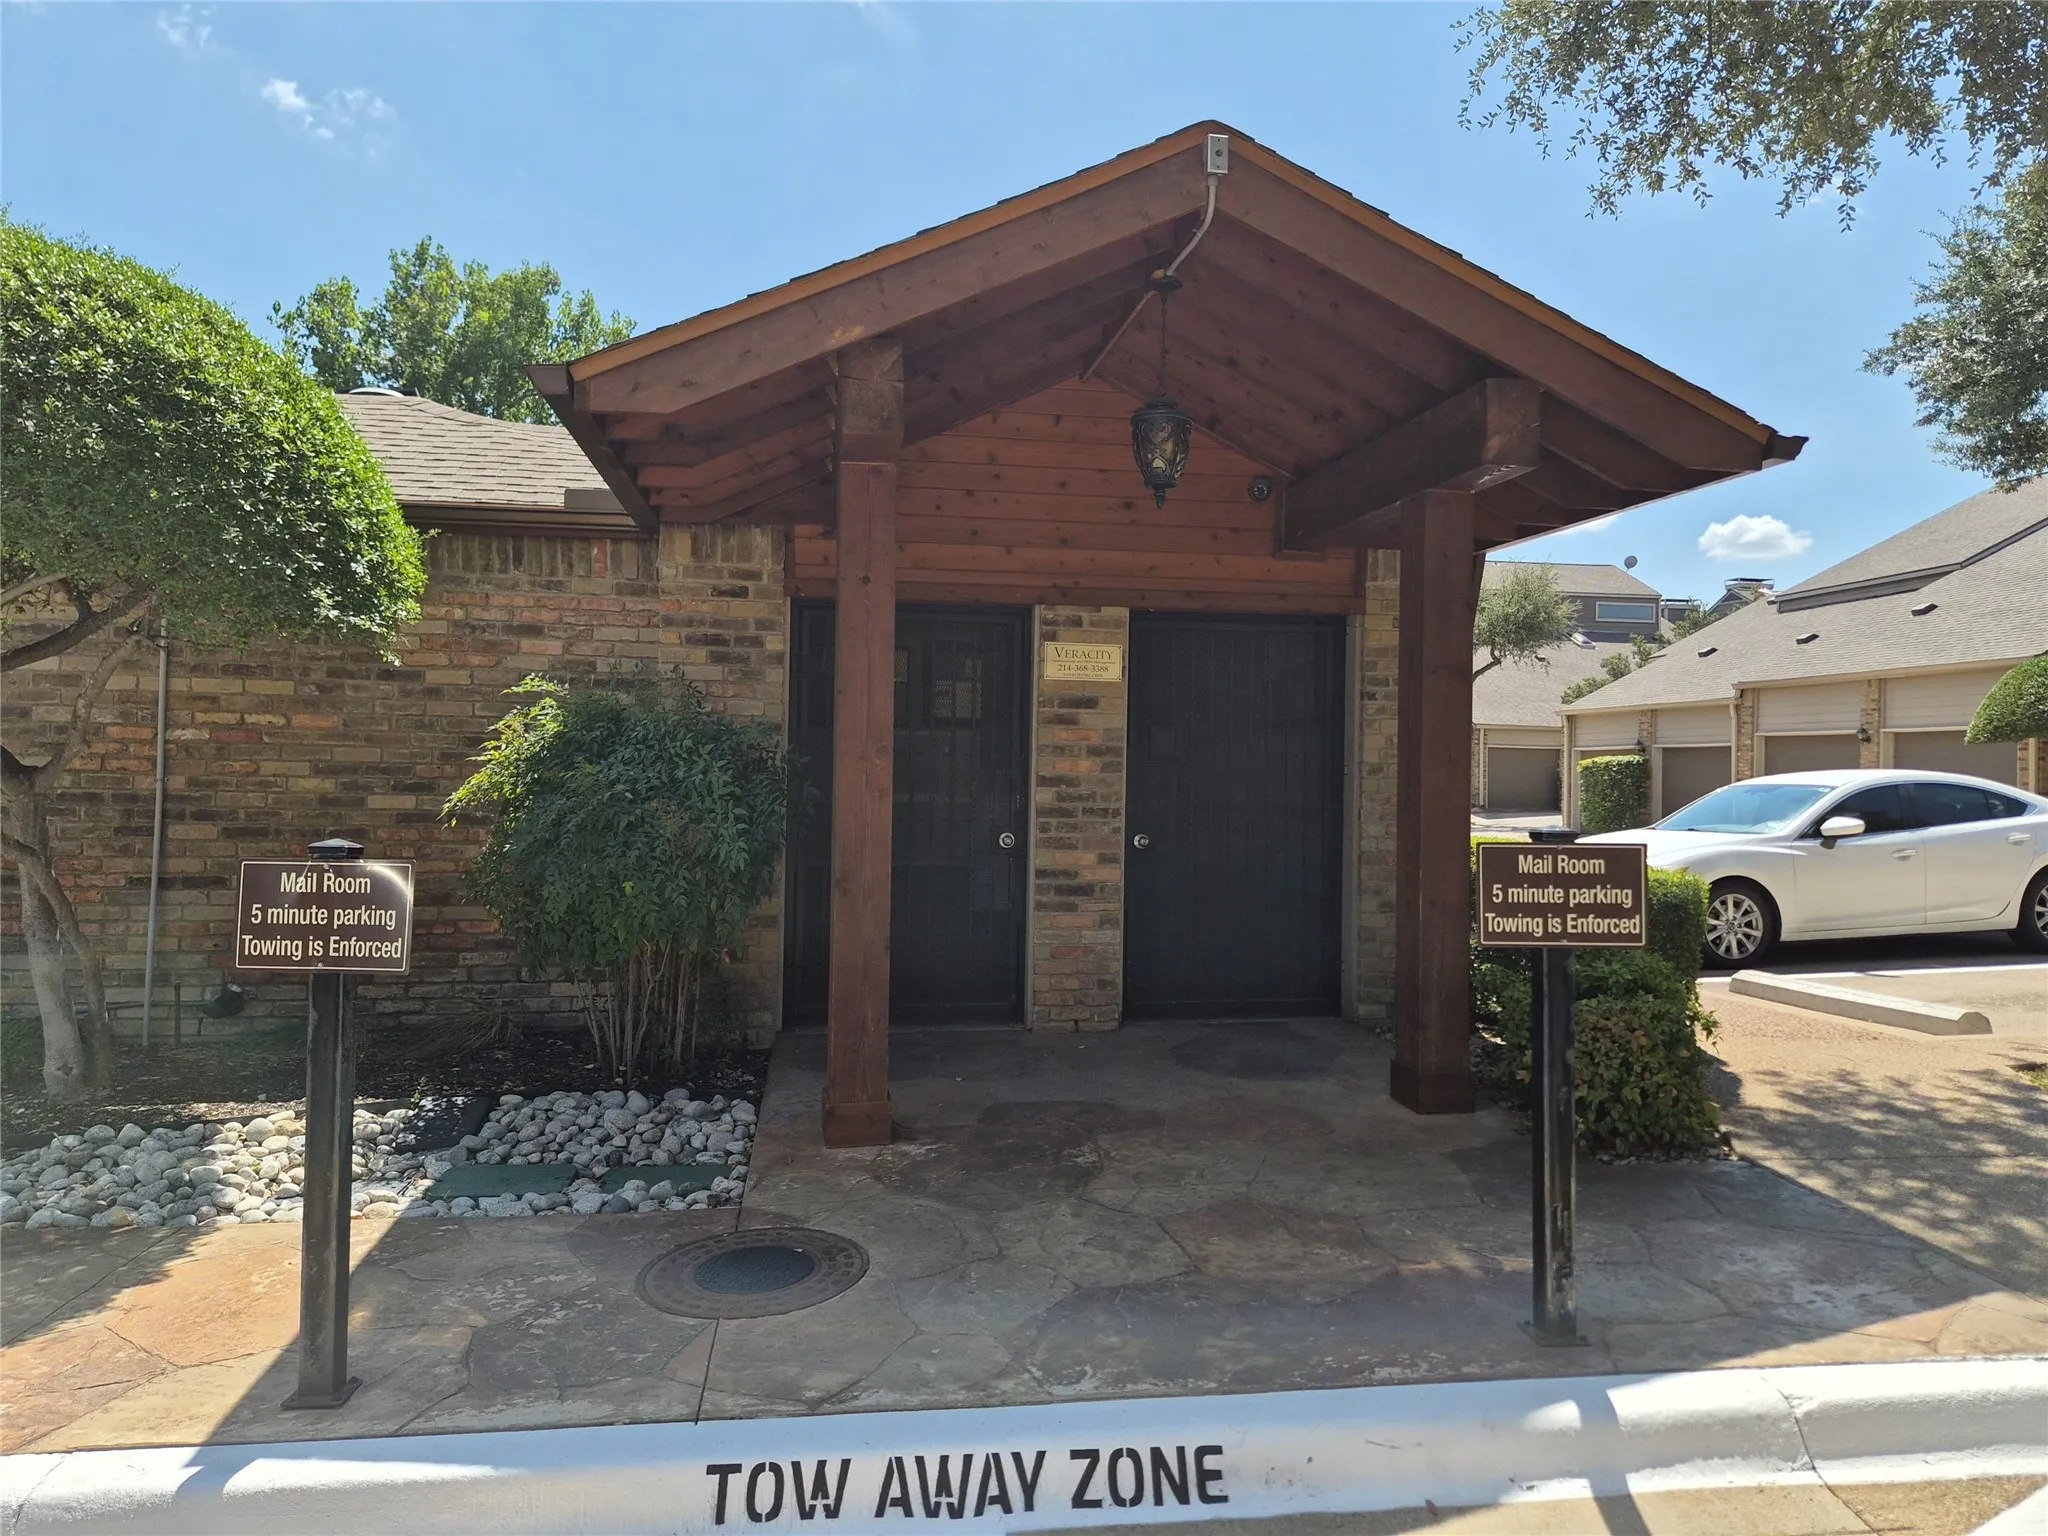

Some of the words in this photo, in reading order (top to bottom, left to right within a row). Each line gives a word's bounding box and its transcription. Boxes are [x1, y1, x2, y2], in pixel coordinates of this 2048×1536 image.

[1054, 647, 1113, 660] VERACITY
[1058, 664, 1109, 673] 214-368-3388
[1518, 854, 1552, 874] Mail
[1557, 855, 1605, 875] Room
[280, 872, 316, 893] Mail
[323, 872, 371, 894] Room
[1492, 884, 1503, 903] 5
[1508, 884, 1564, 904] minute
[1569, 885, 1632, 908] parking
[251, 904, 262, 924] 5
[267, 904, 328, 925] minute
[333, 905, 396, 931] parking
[1485, 913, 1543, 937] Towing
[1548, 914, 1562, 933] is
[1567, 914, 1640, 934] Enforced
[241, 935, 302, 961] Towing
[308, 936, 324, 956] is
[329, 936, 402, 959] Enforced
[705, 1457, 852, 1525] TOW
[874, 1450, 1047, 1519] AWAY
[1069, 1444, 1229, 1509] ZONE
